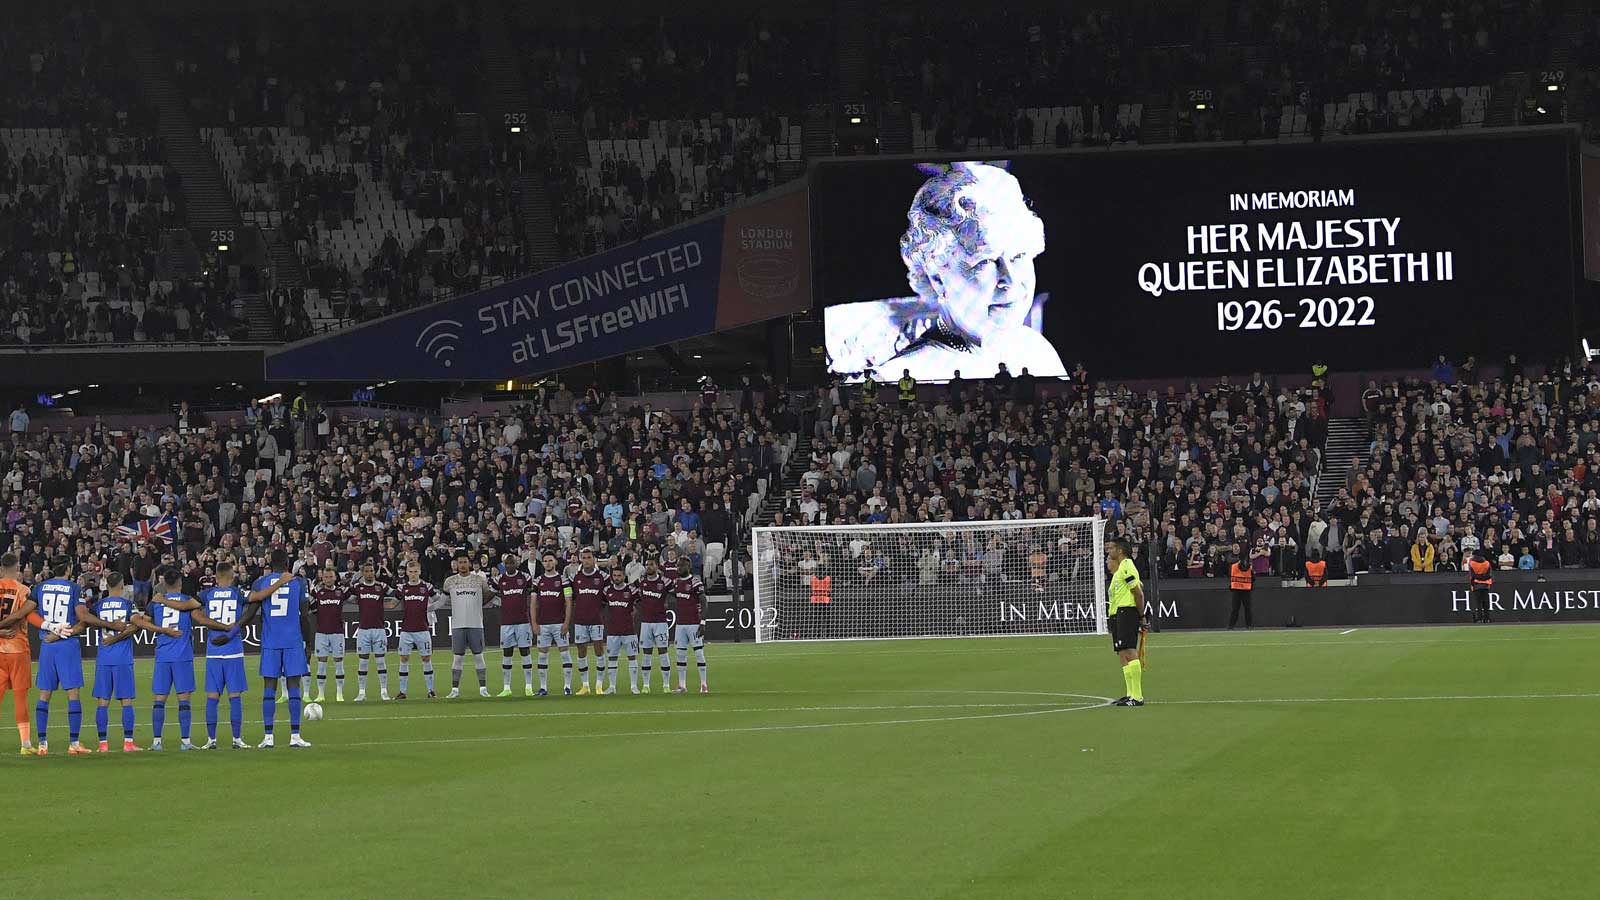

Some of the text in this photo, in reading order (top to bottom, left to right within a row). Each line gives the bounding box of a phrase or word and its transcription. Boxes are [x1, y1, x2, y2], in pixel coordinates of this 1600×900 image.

[1540, 71, 1564, 84] 249
[1188, 89, 1213, 103] 250
[504, 112, 528, 125] 252
[844, 104, 867, 116] 251
[1229, 188, 1355, 211] IN MEMORIAM
[210, 230, 234, 242] 253
[741, 228, 792, 239] LONDON
[1187, 216, 1401, 254] HER MAJESTY
[742, 240, 792, 250] STADIUM
[1138, 251, 1453, 296] QUEEN ELIZABETH II
[478, 240, 702, 334] STAY CONNECTED
[511, 334, 539, 364] at
[270, 586, 290, 616] 5
[503, 588, 524, 596] betway
[578, 588, 600, 596] betway
[642, 590, 662, 599] betway
[1452, 590, 1600, 614] HR MAJEST
[42, 593, 71, 623] 96
[162, 606, 180, 631] 2
[208, 600, 238, 626] 26
[1000, 600, 1180, 621] IN MEMAM
